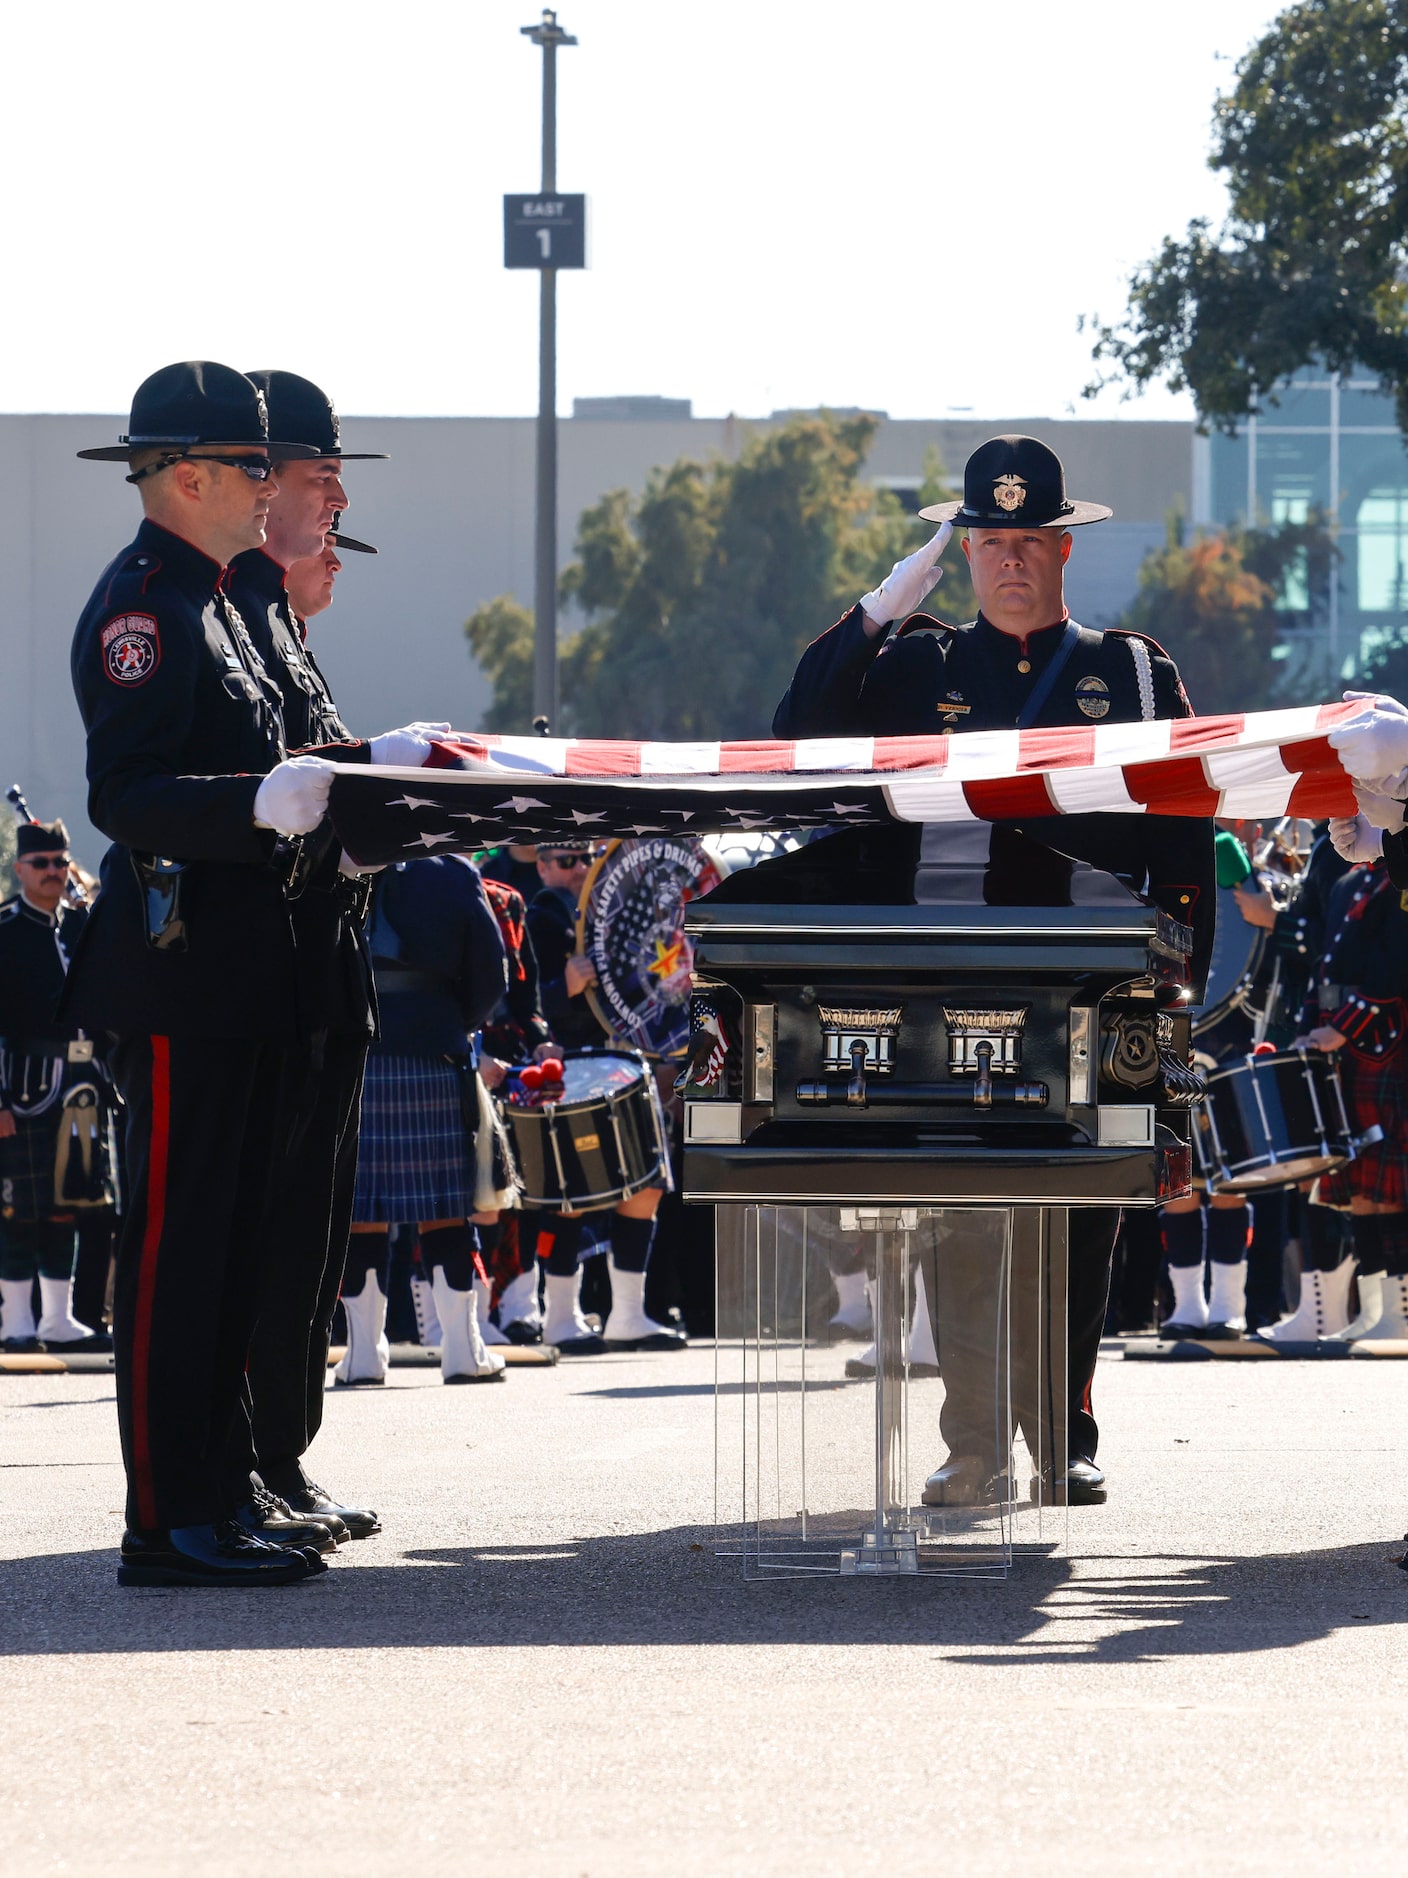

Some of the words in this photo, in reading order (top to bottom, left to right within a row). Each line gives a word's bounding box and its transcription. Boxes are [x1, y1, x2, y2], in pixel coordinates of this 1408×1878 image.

[522, 201, 564, 217] EAST
[536, 228, 551, 259] 1
[113, 636, 146, 653] LEWISVILLE
[120, 668, 143, 678] POLICE
[621, 844, 652, 873] PIPES
[653, 843, 664, 858] &
[664, 843, 704, 877] DRUMS
[596, 864, 625, 918] SAFETY
[593, 918, 608, 971] PUBLIC
[600, 971, 642, 1029] COWTOWN
